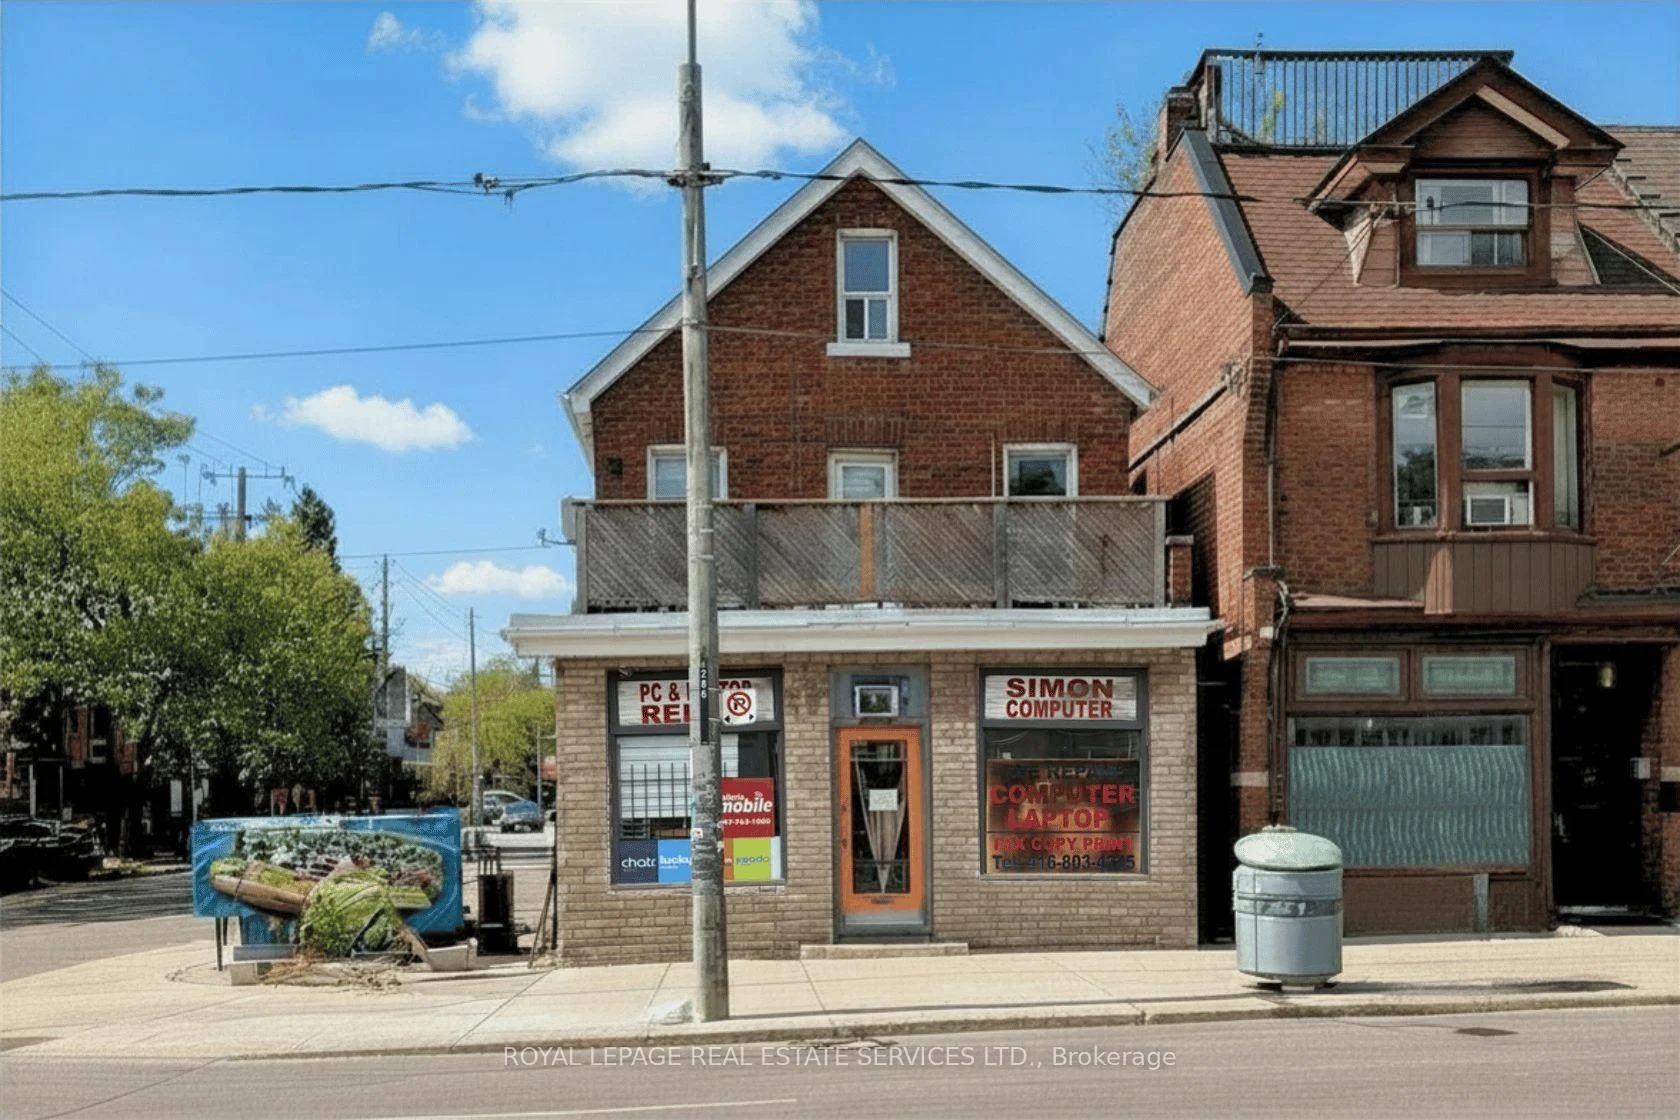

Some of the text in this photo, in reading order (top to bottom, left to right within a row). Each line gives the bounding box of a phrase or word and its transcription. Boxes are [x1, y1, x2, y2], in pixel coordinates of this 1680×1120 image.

[640, 683, 661, 702] PC
[669, 682, 680, 702] &
[1006, 678, 1113, 698] SIMON
[1006, 700, 1113, 718] COMPUTER
[990, 784, 1136, 804] COMPUTER
[1006, 808, 1110, 831] LAPTOP
